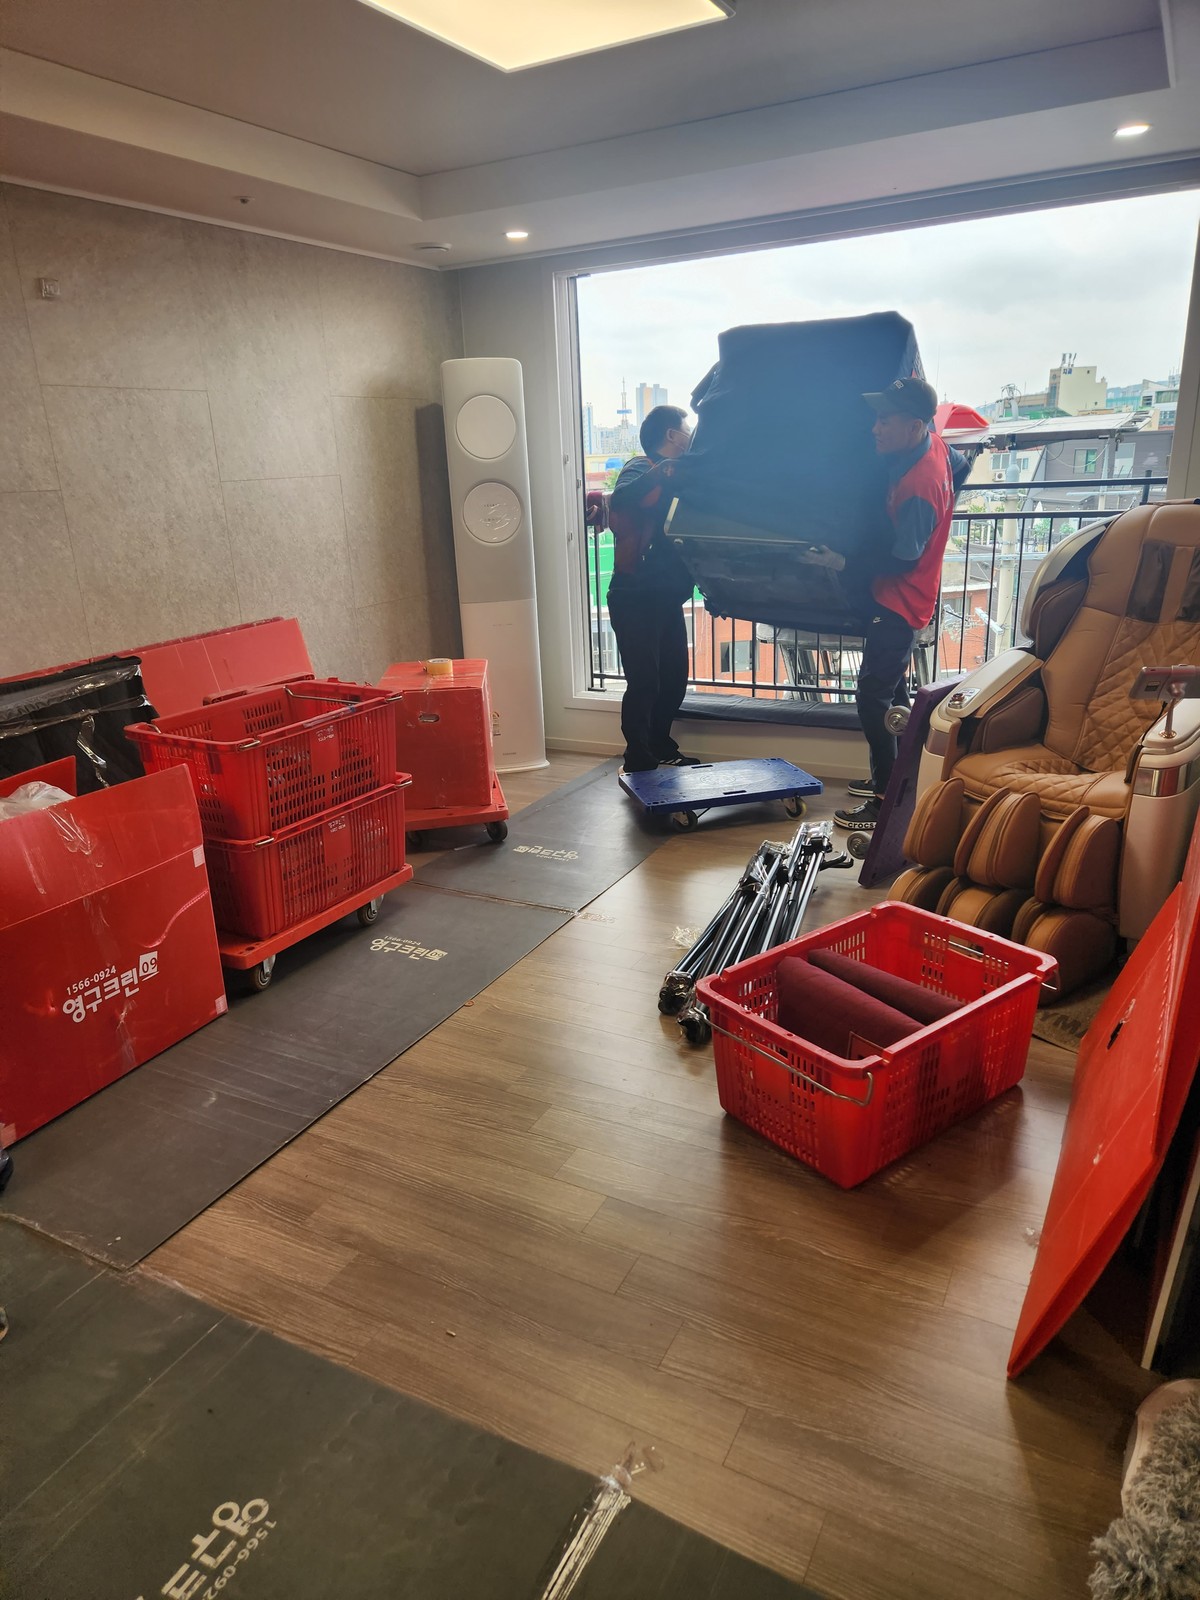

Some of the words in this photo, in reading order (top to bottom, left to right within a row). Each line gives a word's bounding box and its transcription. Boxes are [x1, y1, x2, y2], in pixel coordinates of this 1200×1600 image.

[369, 938, 430, 960] 영구크린
[62, 967, 140, 1023] 영구크린
[66, 965, 117, 996] 1566-0924
[136, 1498, 270, 1600] 영구크
[202, 1520, 277, 1600] 1566-092
